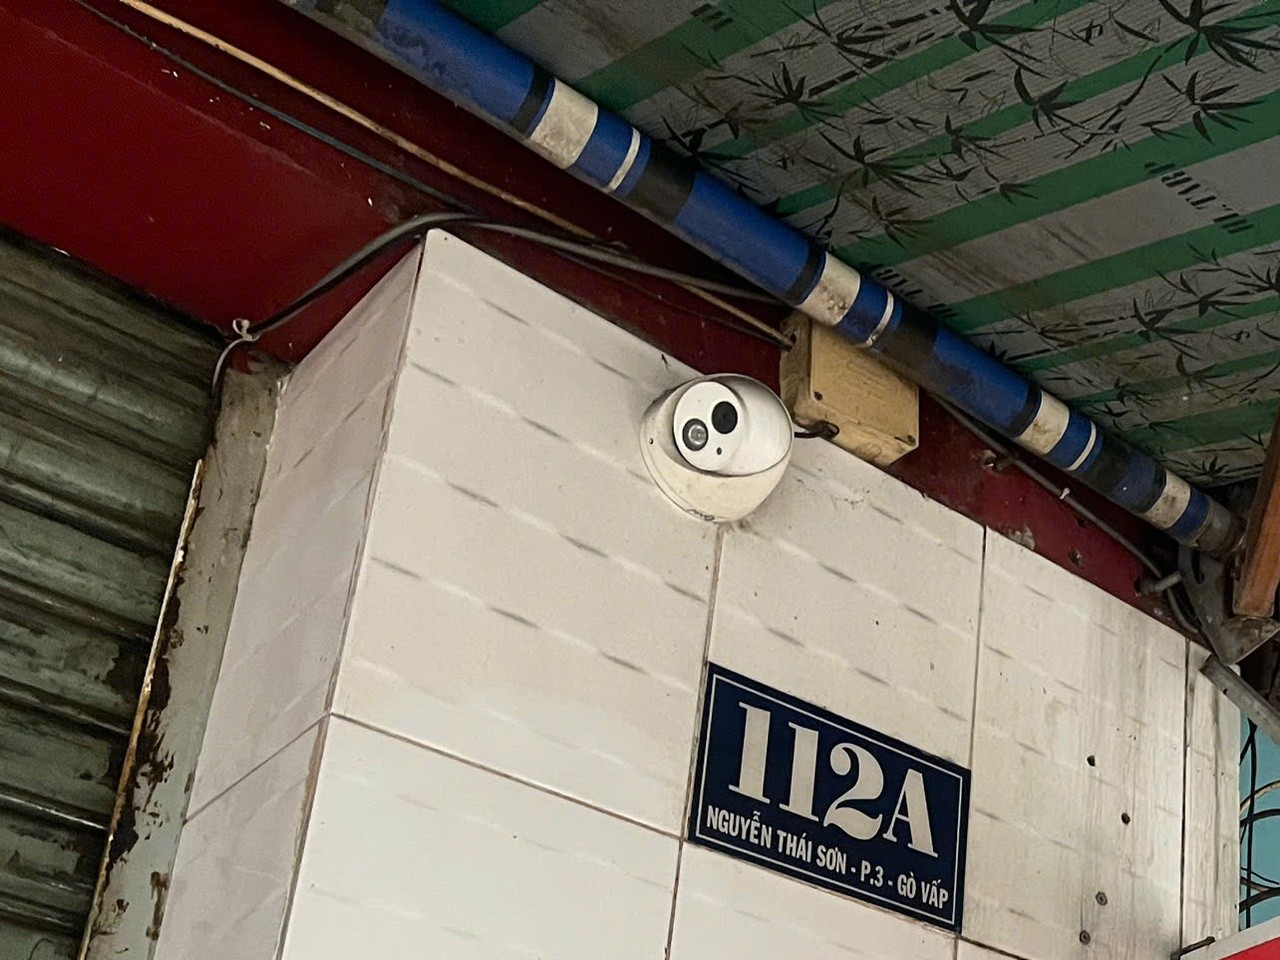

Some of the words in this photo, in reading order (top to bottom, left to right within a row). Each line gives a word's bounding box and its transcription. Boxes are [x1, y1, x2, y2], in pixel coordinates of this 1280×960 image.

[728, 701, 939, 859] 112A
[706, 804, 773, 849] NGUYỄN
[777, 831, 813, 864] THÁI
[816, 844, 848, 876] SƠN
[860, 859, 885, 888] P.3
[897, 870, 917, 900] GÒ
[921, 878, 949, 910] VẤP
